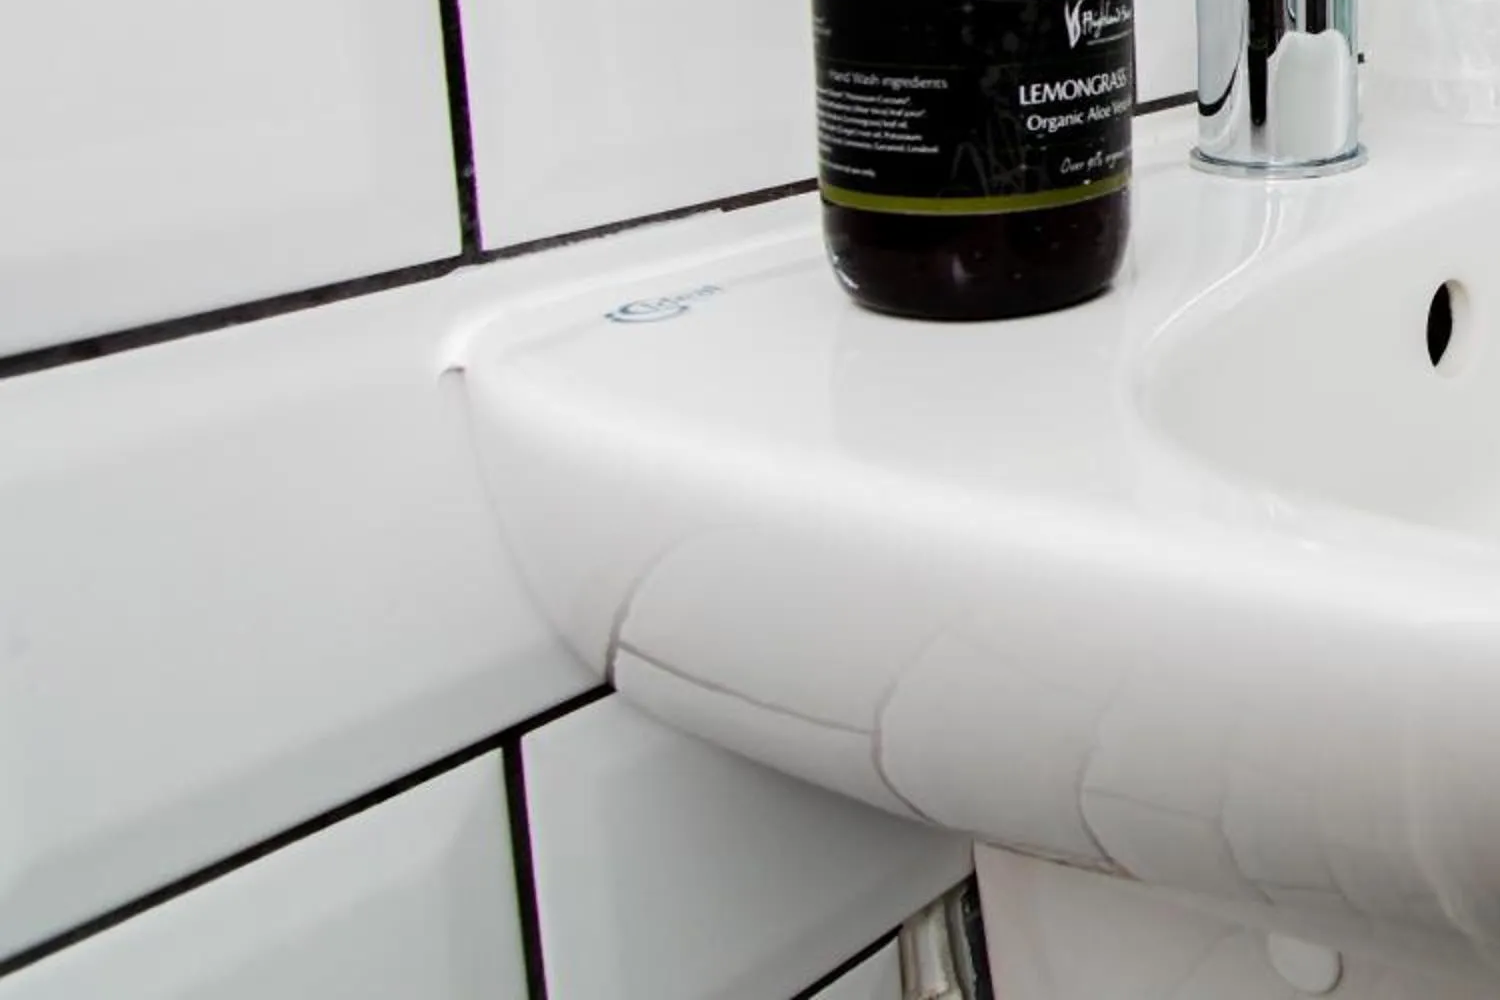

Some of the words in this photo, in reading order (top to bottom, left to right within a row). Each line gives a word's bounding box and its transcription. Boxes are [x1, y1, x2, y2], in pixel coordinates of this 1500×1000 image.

[882, 75, 948, 90] ingredients
[1018, 66, 1128, 105] LEMONGRASS
[1026, 109, 1084, 133] Organic
[1087, 103, 1111, 121] Aloe
